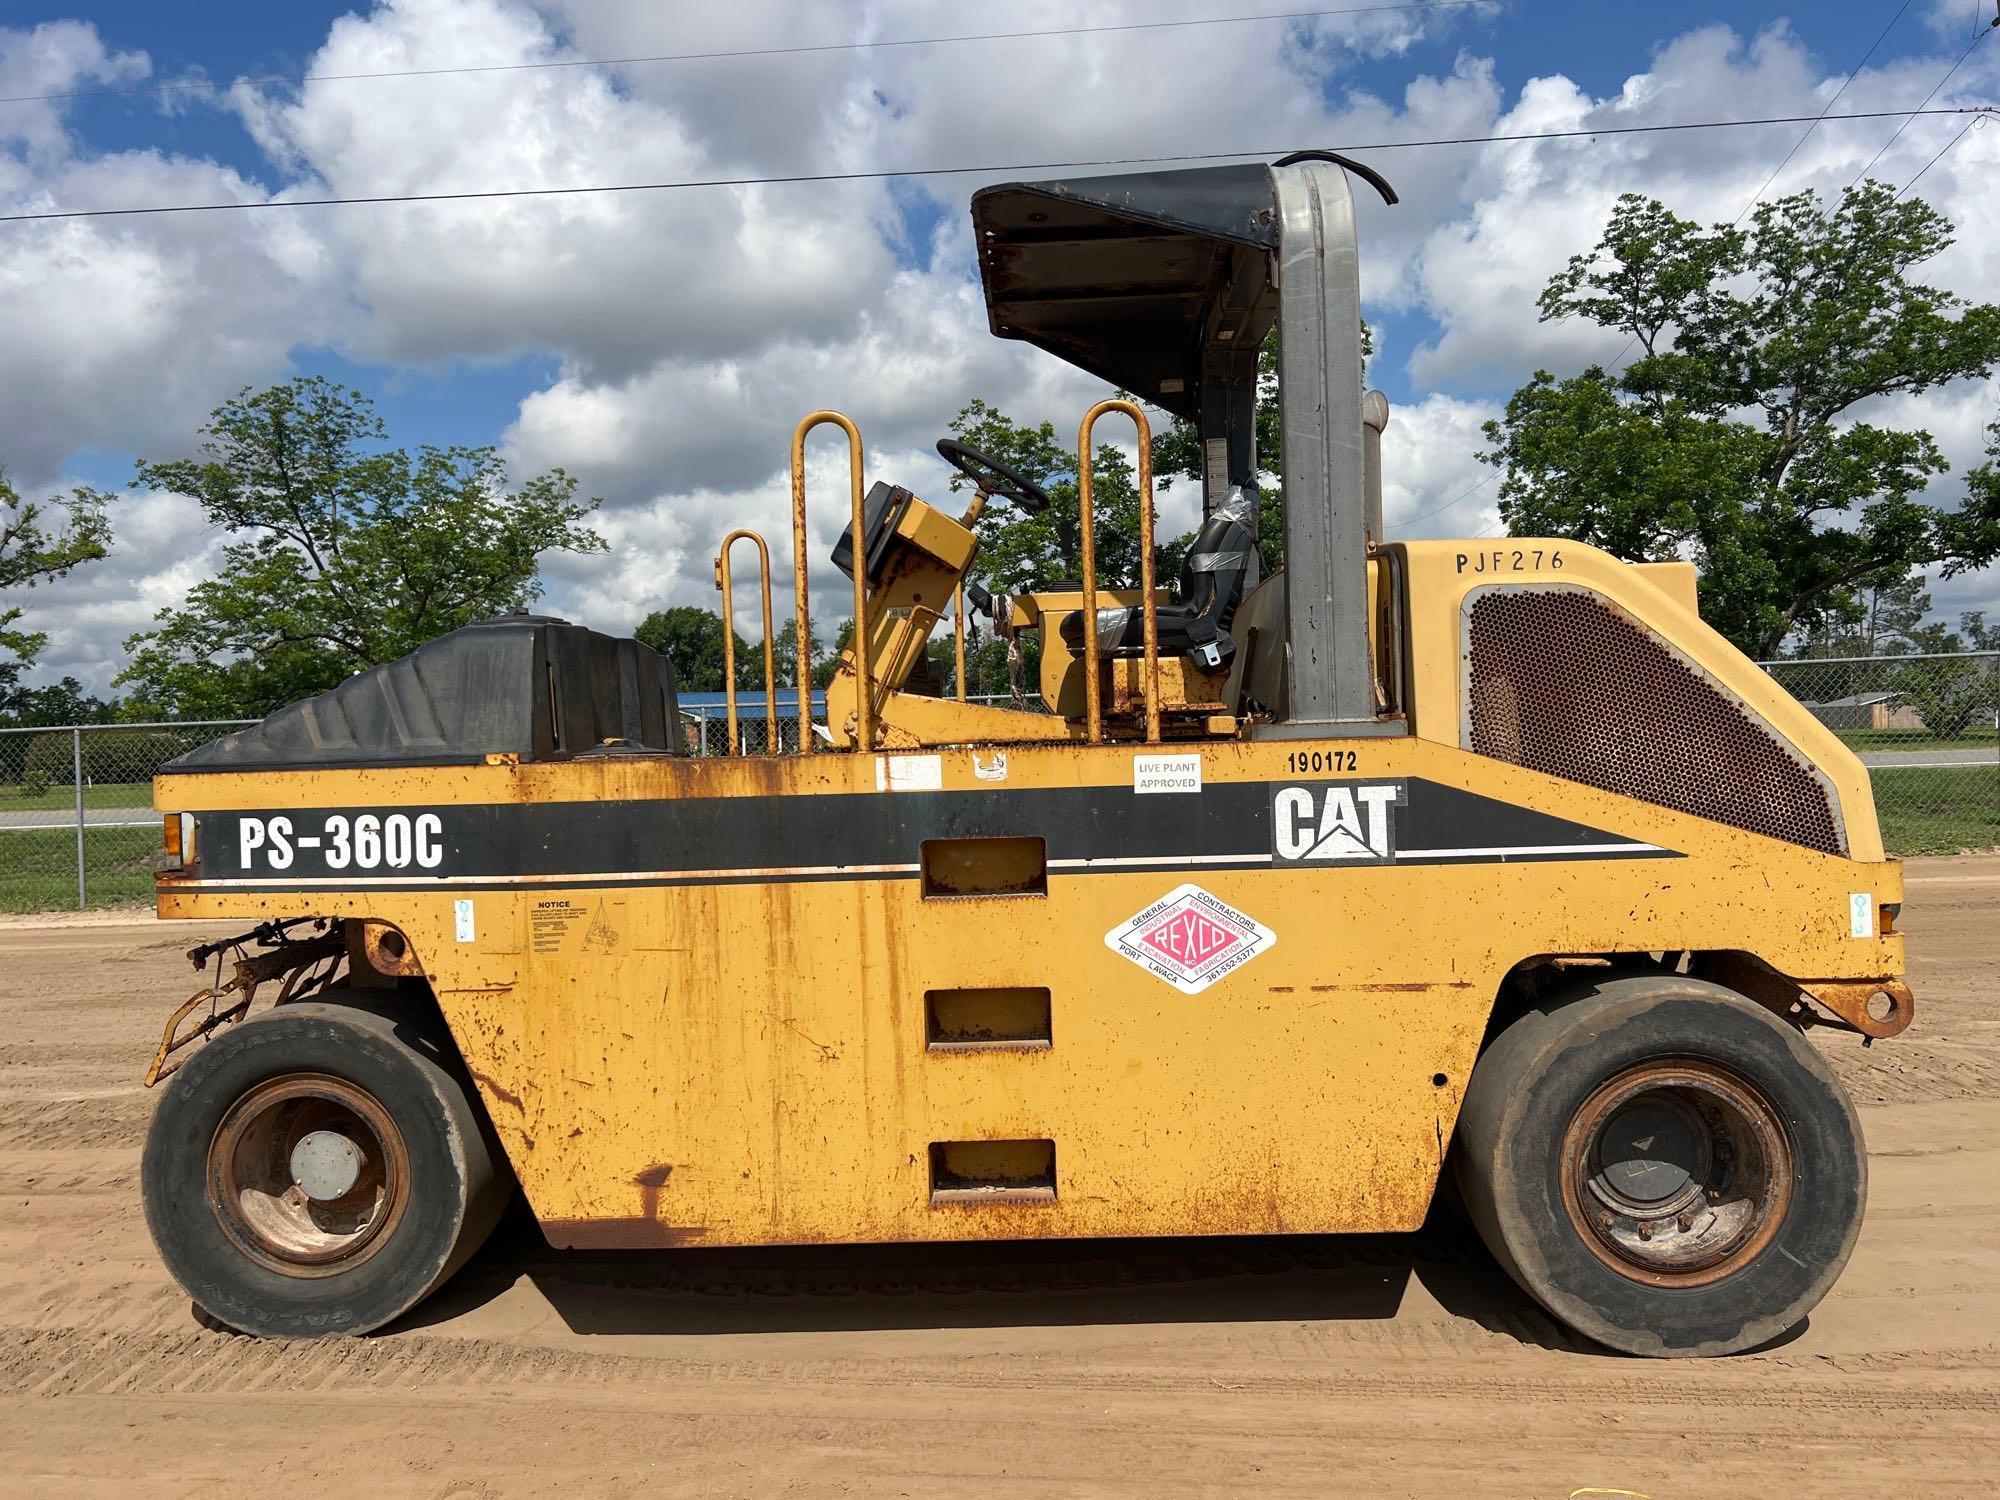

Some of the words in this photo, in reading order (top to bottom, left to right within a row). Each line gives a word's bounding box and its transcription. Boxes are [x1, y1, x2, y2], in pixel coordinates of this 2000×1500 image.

[1139, 763, 1160, 773] LIVE
[1163, 762, 1196, 773] PLANT
[1288, 750, 1357, 773] 190172
[1140, 778, 1196, 789] APPROVED
[1274, 785, 1397, 860] CAT
[239, 813, 443, 870] PS-360C
[538, 901, 570, 909] NOTICE
[1132, 901, 1169, 926] GENERAL
[1197, 892, 1256, 931] CONTRACTORS
[1139, 904, 1183, 935] INDUSTRIAL
[1189, 899, 1249, 939] ENVIRONMENTAL
[1154, 914, 1225, 959] REXCO
[1119, 944, 1142, 961] PORT
[1148, 961, 1178, 984] LAVACA
[1137, 942, 1186, 974] EXCAVATION
[1194, 942, 1243, 976] FABRICATION
[1205, 947, 1256, 983] 361-552-5371
